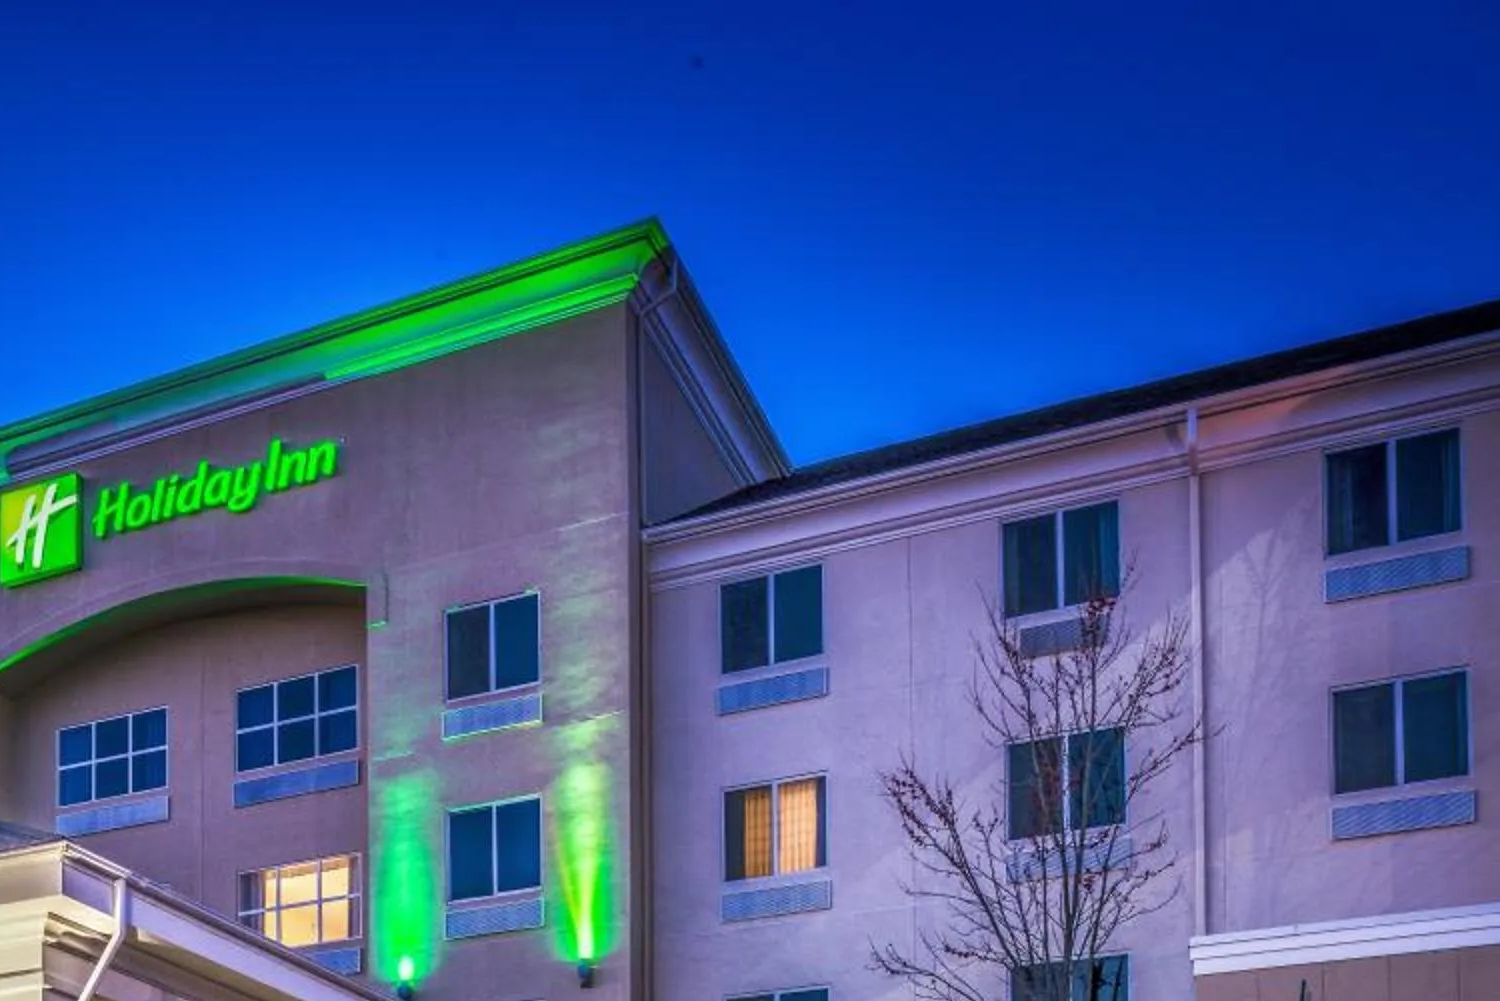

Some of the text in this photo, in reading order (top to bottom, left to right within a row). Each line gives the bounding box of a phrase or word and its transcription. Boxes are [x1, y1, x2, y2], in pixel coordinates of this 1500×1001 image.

[6, 484, 77, 568] H
[93, 438, 336, 539] Holiday Inn
